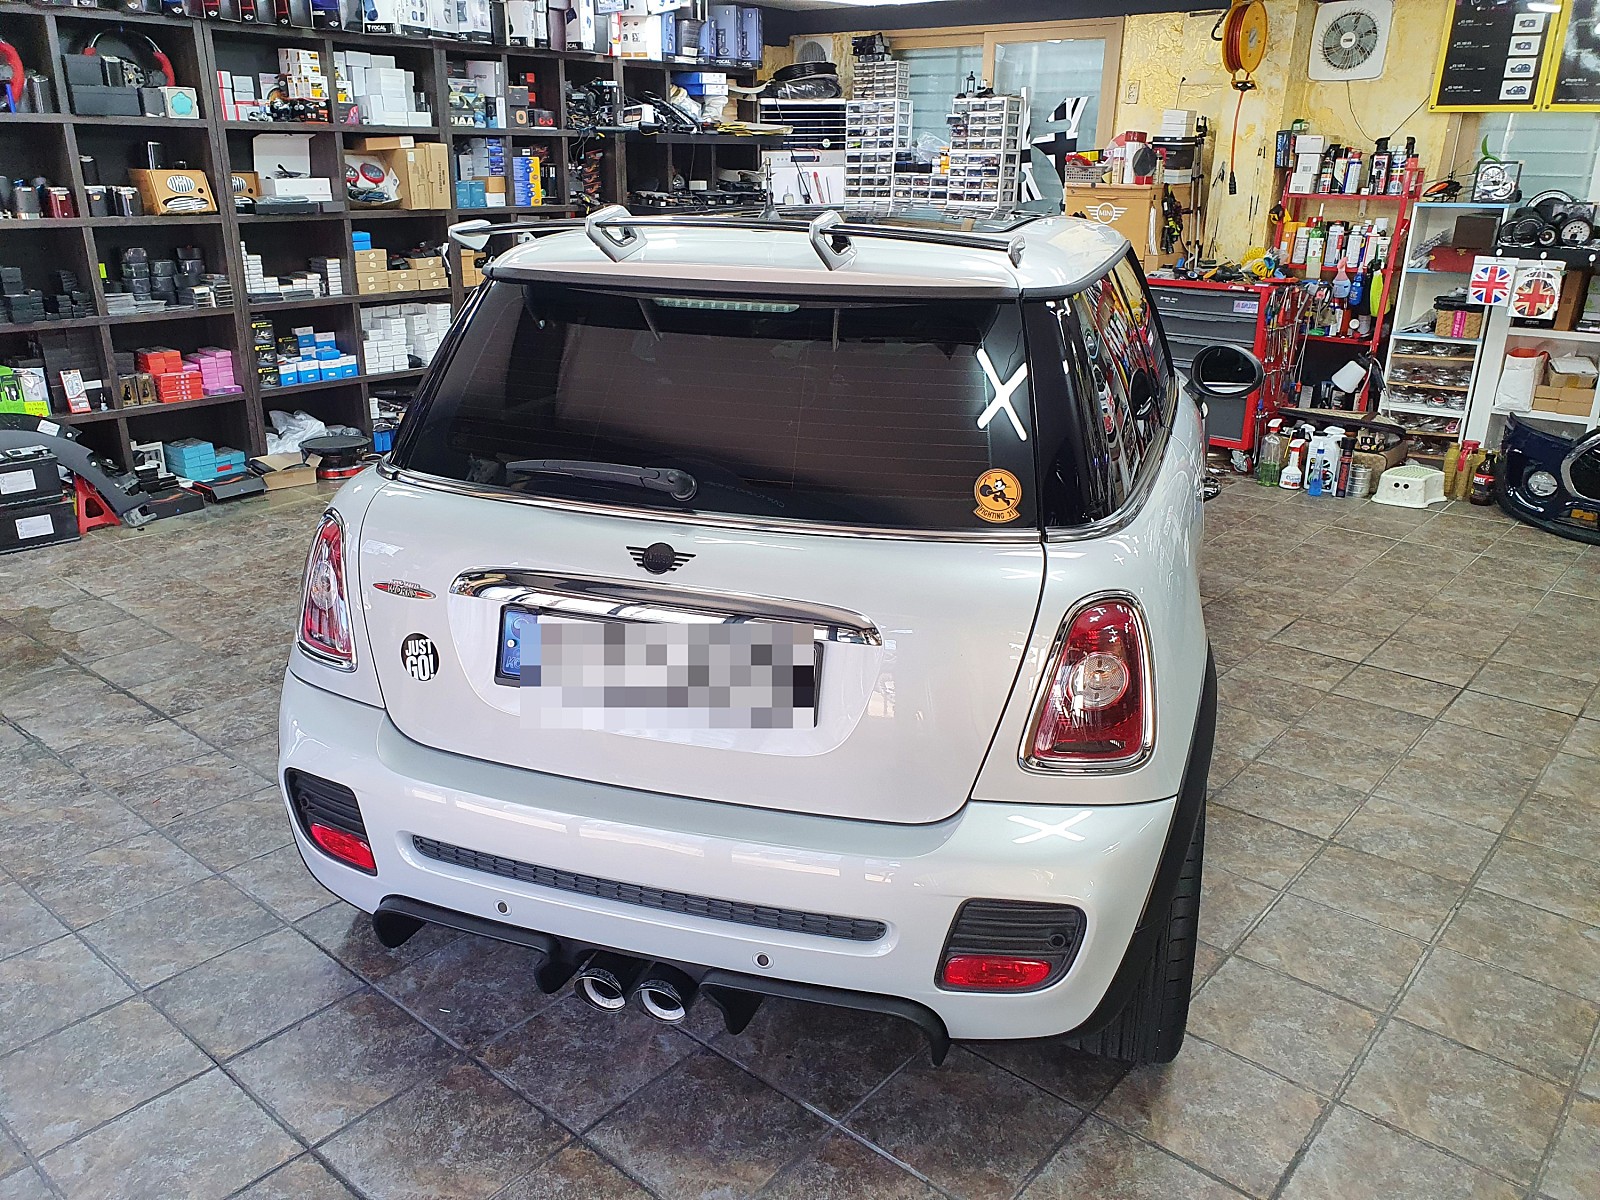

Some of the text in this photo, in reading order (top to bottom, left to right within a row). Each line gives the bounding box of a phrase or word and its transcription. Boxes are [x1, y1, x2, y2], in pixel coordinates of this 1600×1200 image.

[1098, 209, 1114, 217] MINI
[388, 583, 416, 598] WORKS
[405, 638, 432, 656] JUST
[406, 654, 435, 681] GO!
